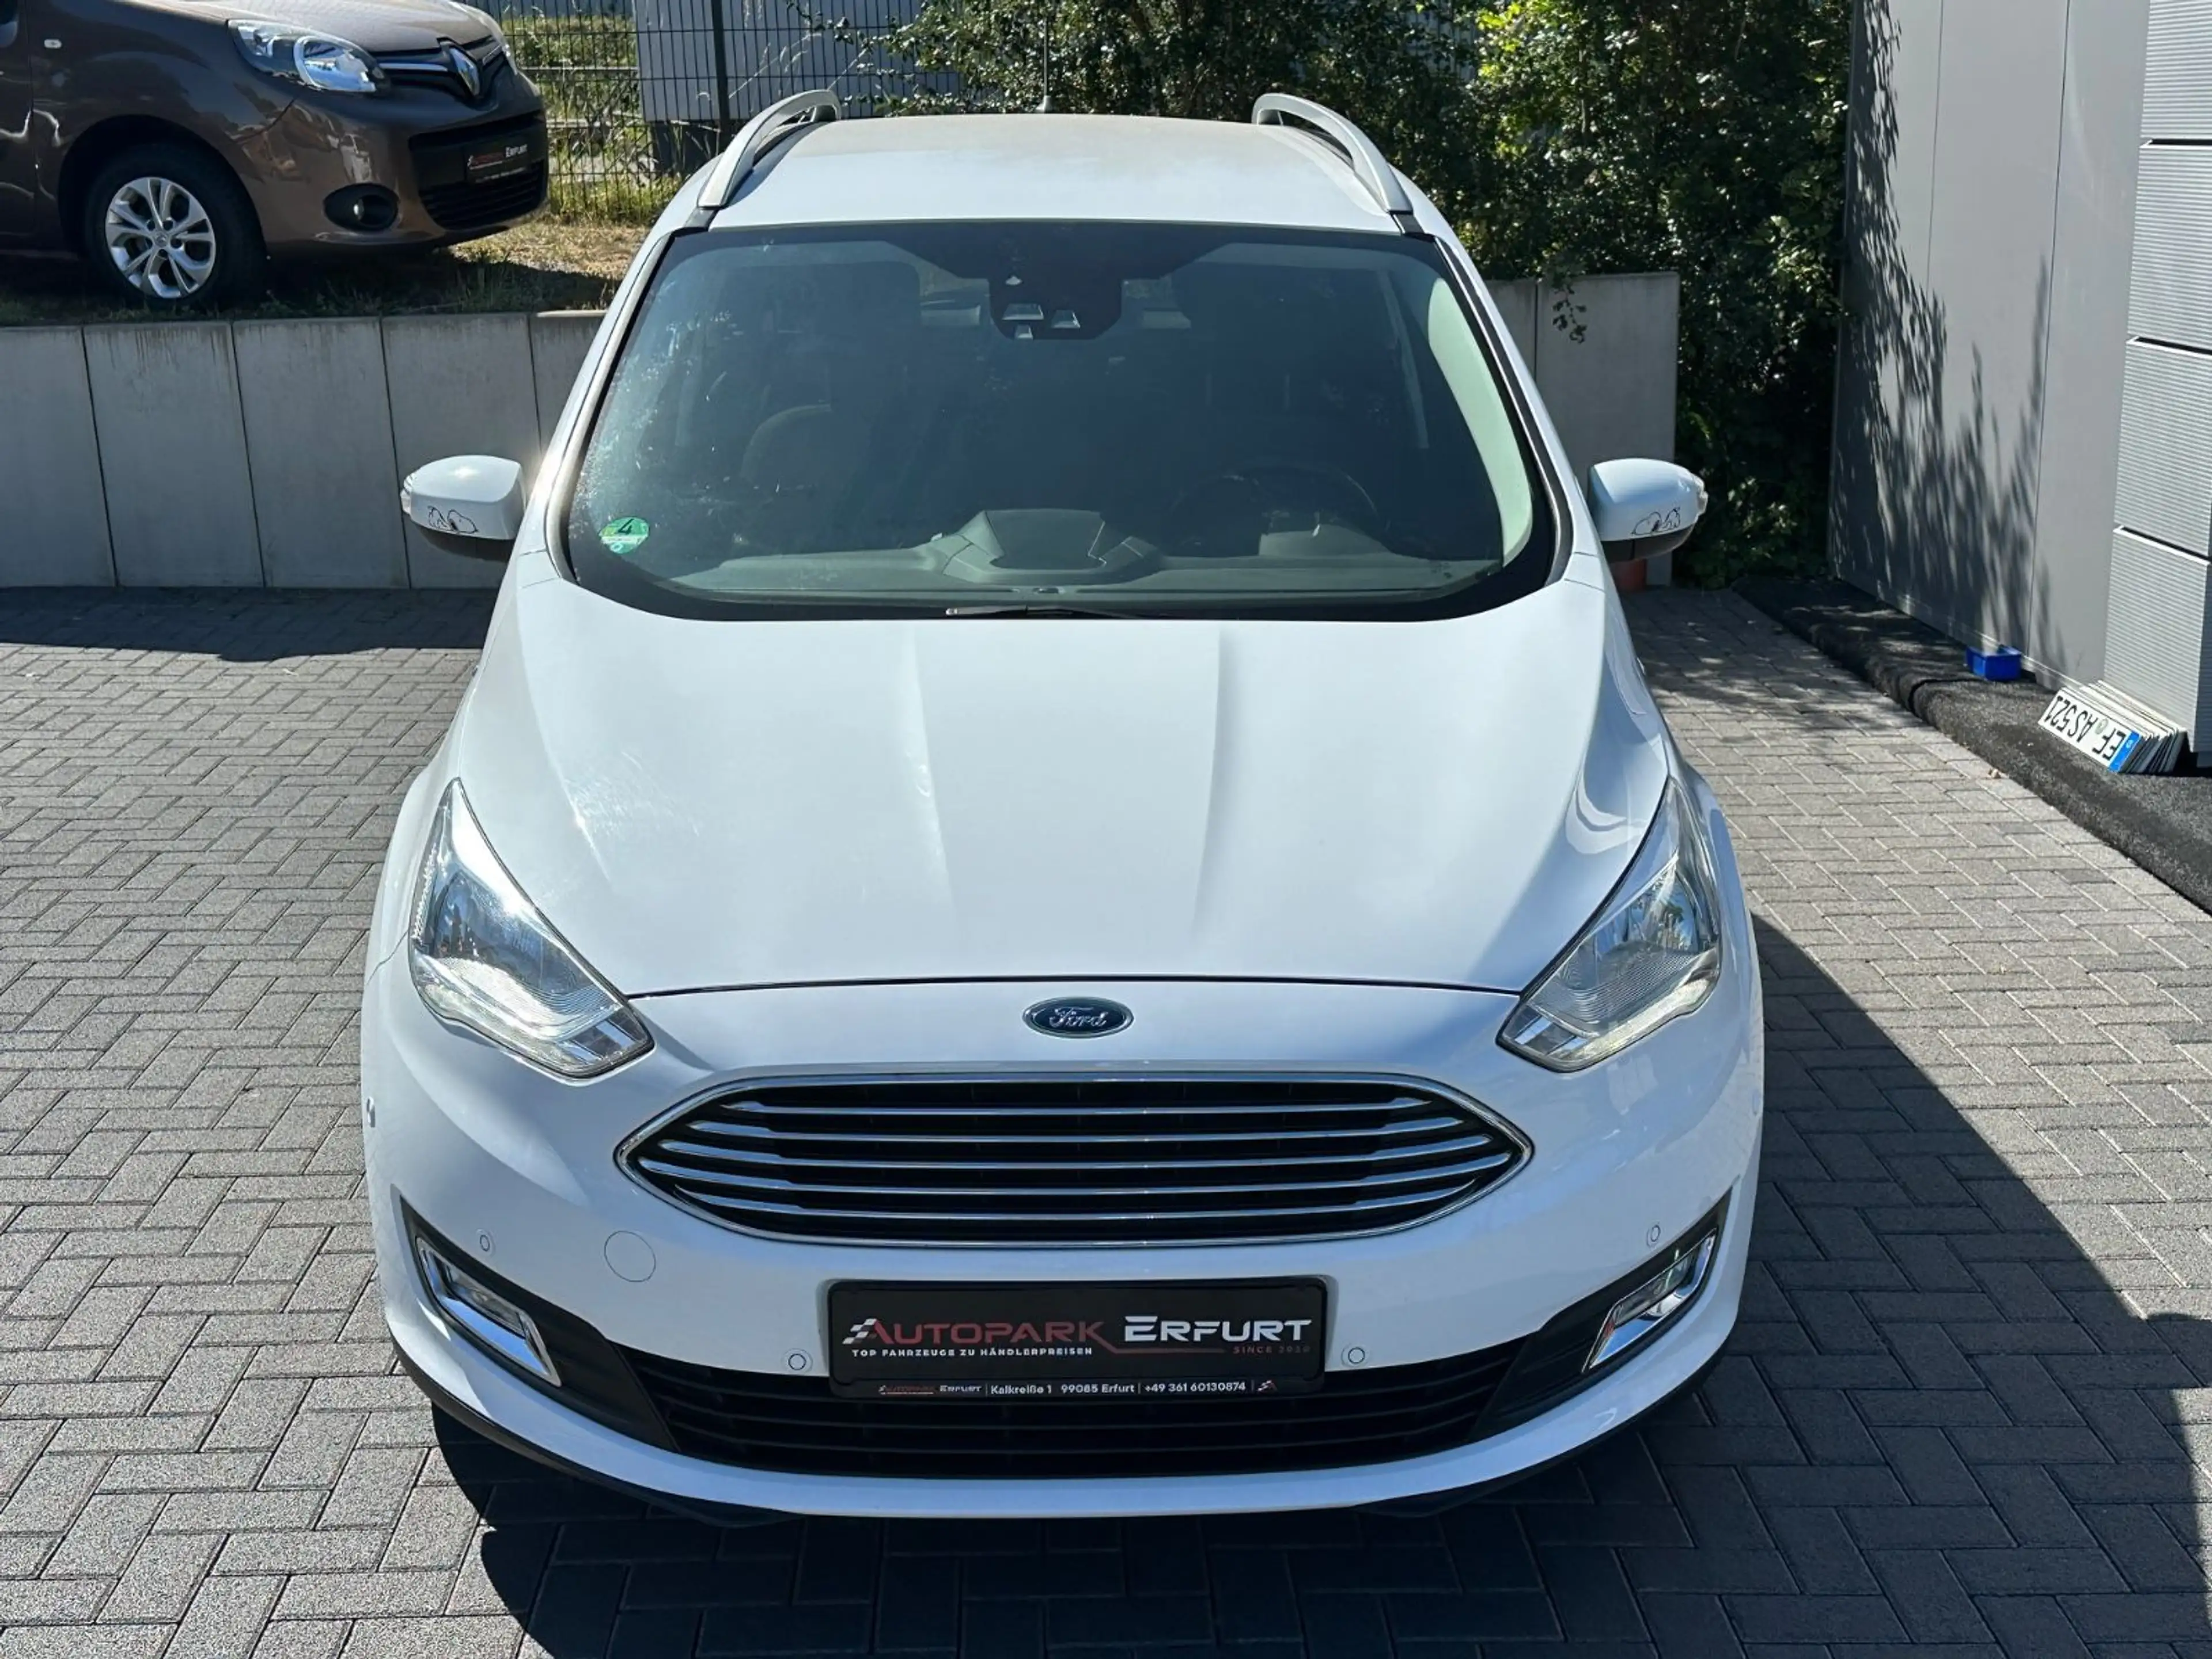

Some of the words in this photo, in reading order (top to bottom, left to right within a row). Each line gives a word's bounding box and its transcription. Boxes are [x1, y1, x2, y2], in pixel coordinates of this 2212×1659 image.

[618, 518, 634, 535] 4
[2092, 728, 2127, 761] EF
[1048, 1007, 1109, 1028] Ford
[842, 1318, 1105, 1344] AUTOPARK
[1124, 1316, 1313, 1342] ERFURT
[851, 1349, 877, 1357] TOP
[881, 1349, 956, 1357] FAHRZEUGE
[959, 1348, 976, 1356] ZU
[1047, 1385, 1052, 1393] 1
[1060, 1384, 1099, 1393] 99085
[1101, 1384, 1135, 1393] Erfurt
[1145, 1384, 1166, 1392] +49
[1168, 1383, 1188, 1392] 361
[1190, 1382, 1246, 1392] 60130874
